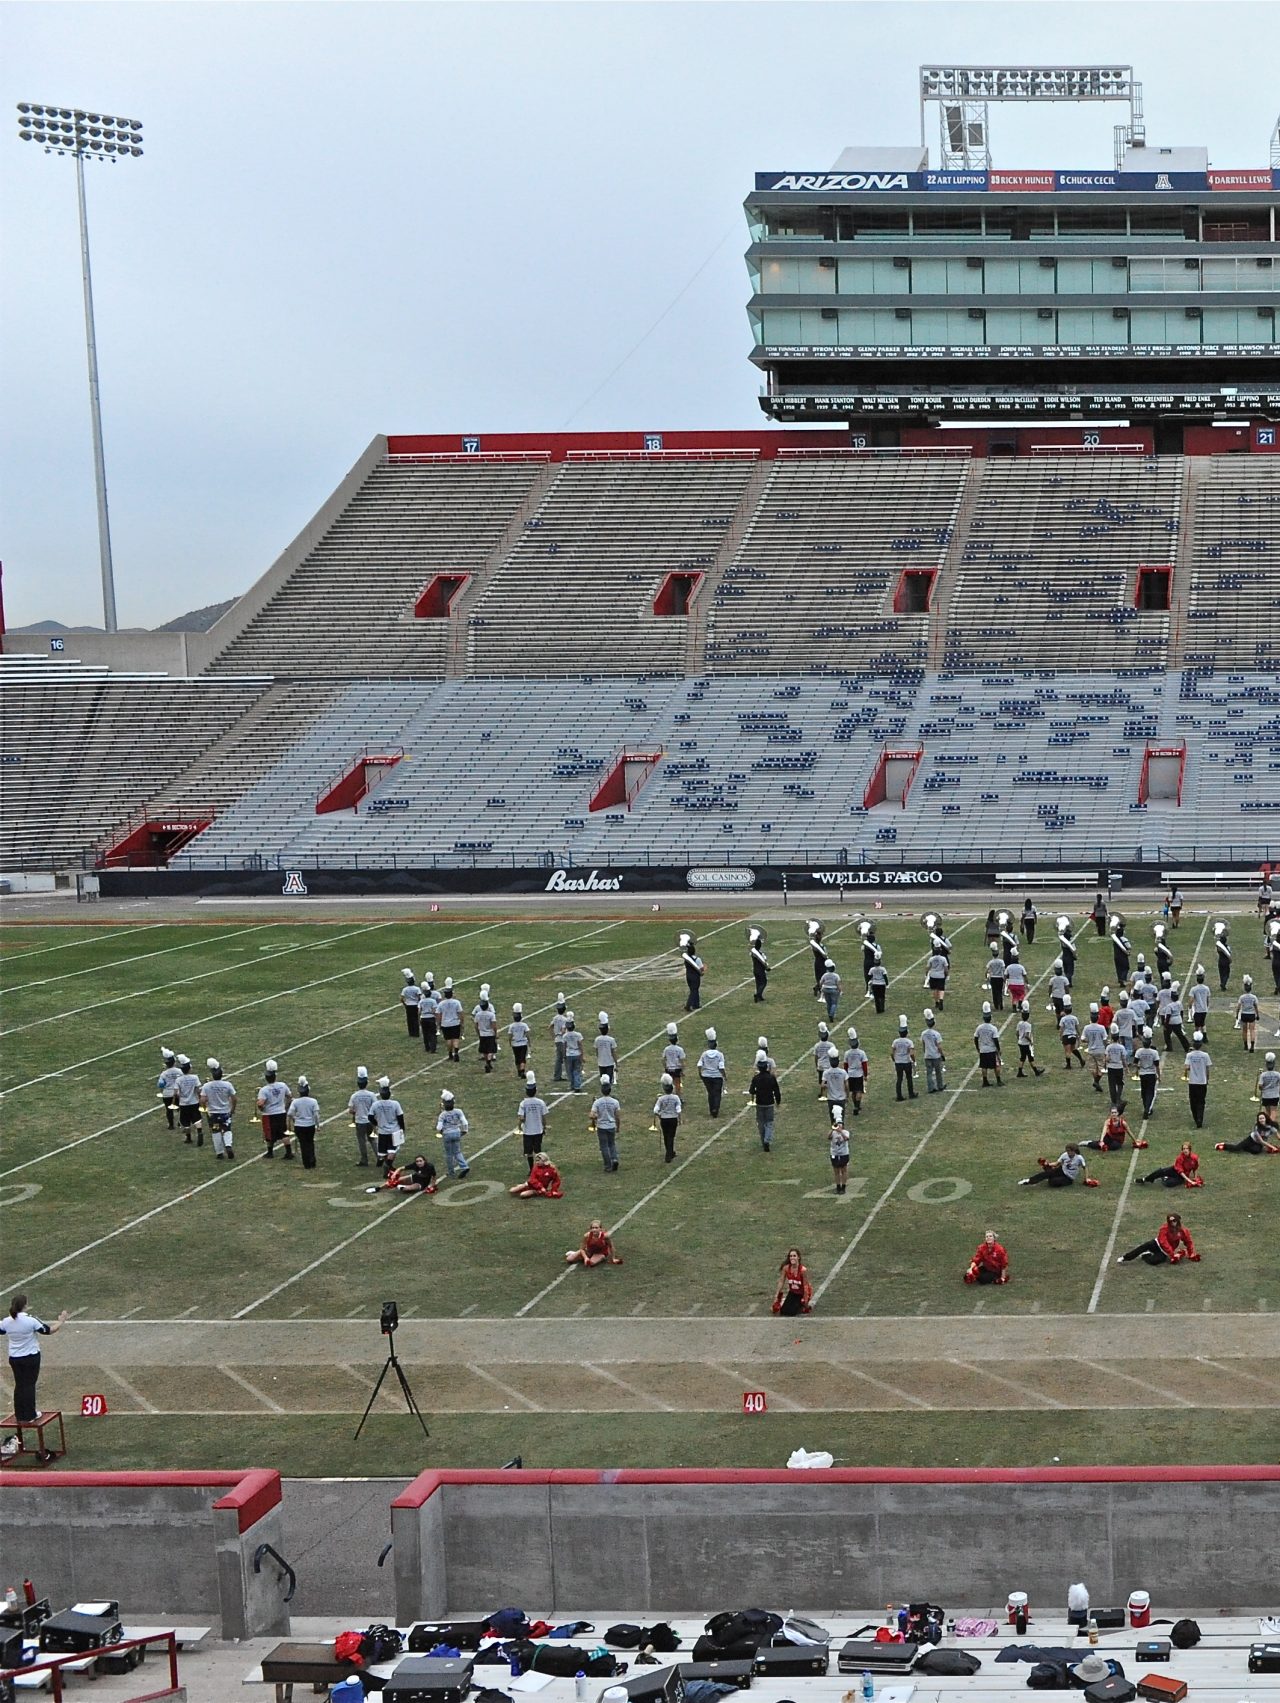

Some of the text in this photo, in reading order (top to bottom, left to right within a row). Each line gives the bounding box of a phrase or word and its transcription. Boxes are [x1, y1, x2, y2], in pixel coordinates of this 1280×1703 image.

[771, 175, 908, 190] ARIZONA
[1209, 176, 1214, 184] 4
[853, 438, 866, 448] 19
[1084, 435, 1099, 445] 20
[1260, 433, 1272, 443] 21
[465, 442, 477, 452] 17
[647, 440, 660, 450] 18
[51, 640, 63, 650] 16
[545, 870, 623, 891] Bashas'
[820, 871, 942, 884] WELLS FARGO
[83, 1396, 102, 1414] 30
[746, 1394, 763, 1411] 40
